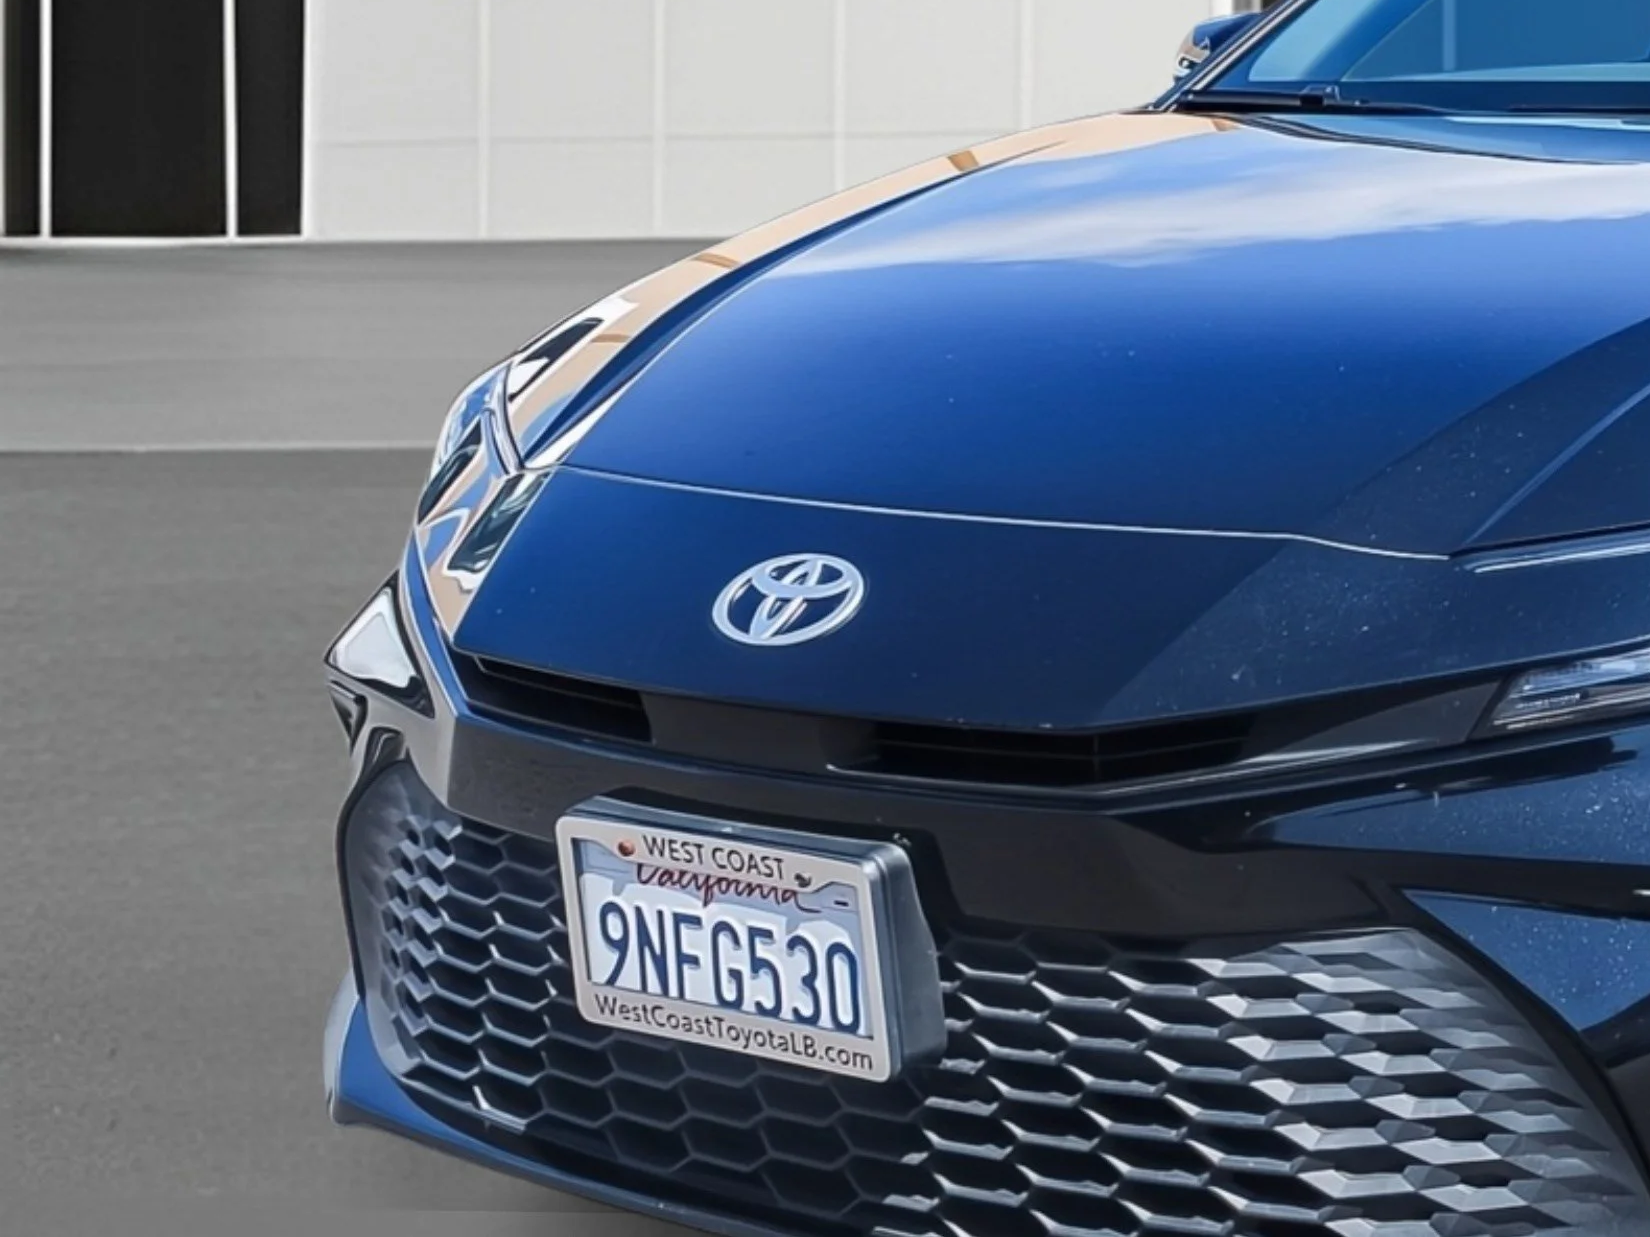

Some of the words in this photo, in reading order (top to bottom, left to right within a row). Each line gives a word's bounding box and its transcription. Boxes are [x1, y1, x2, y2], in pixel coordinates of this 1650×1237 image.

[642, 835, 705, 865] WEST
[711, 847, 784, 880] COAST
[600, 900, 860, 1034] 9NFG530
[595, 993, 874, 1071] WestCoastToyotaLB.com
